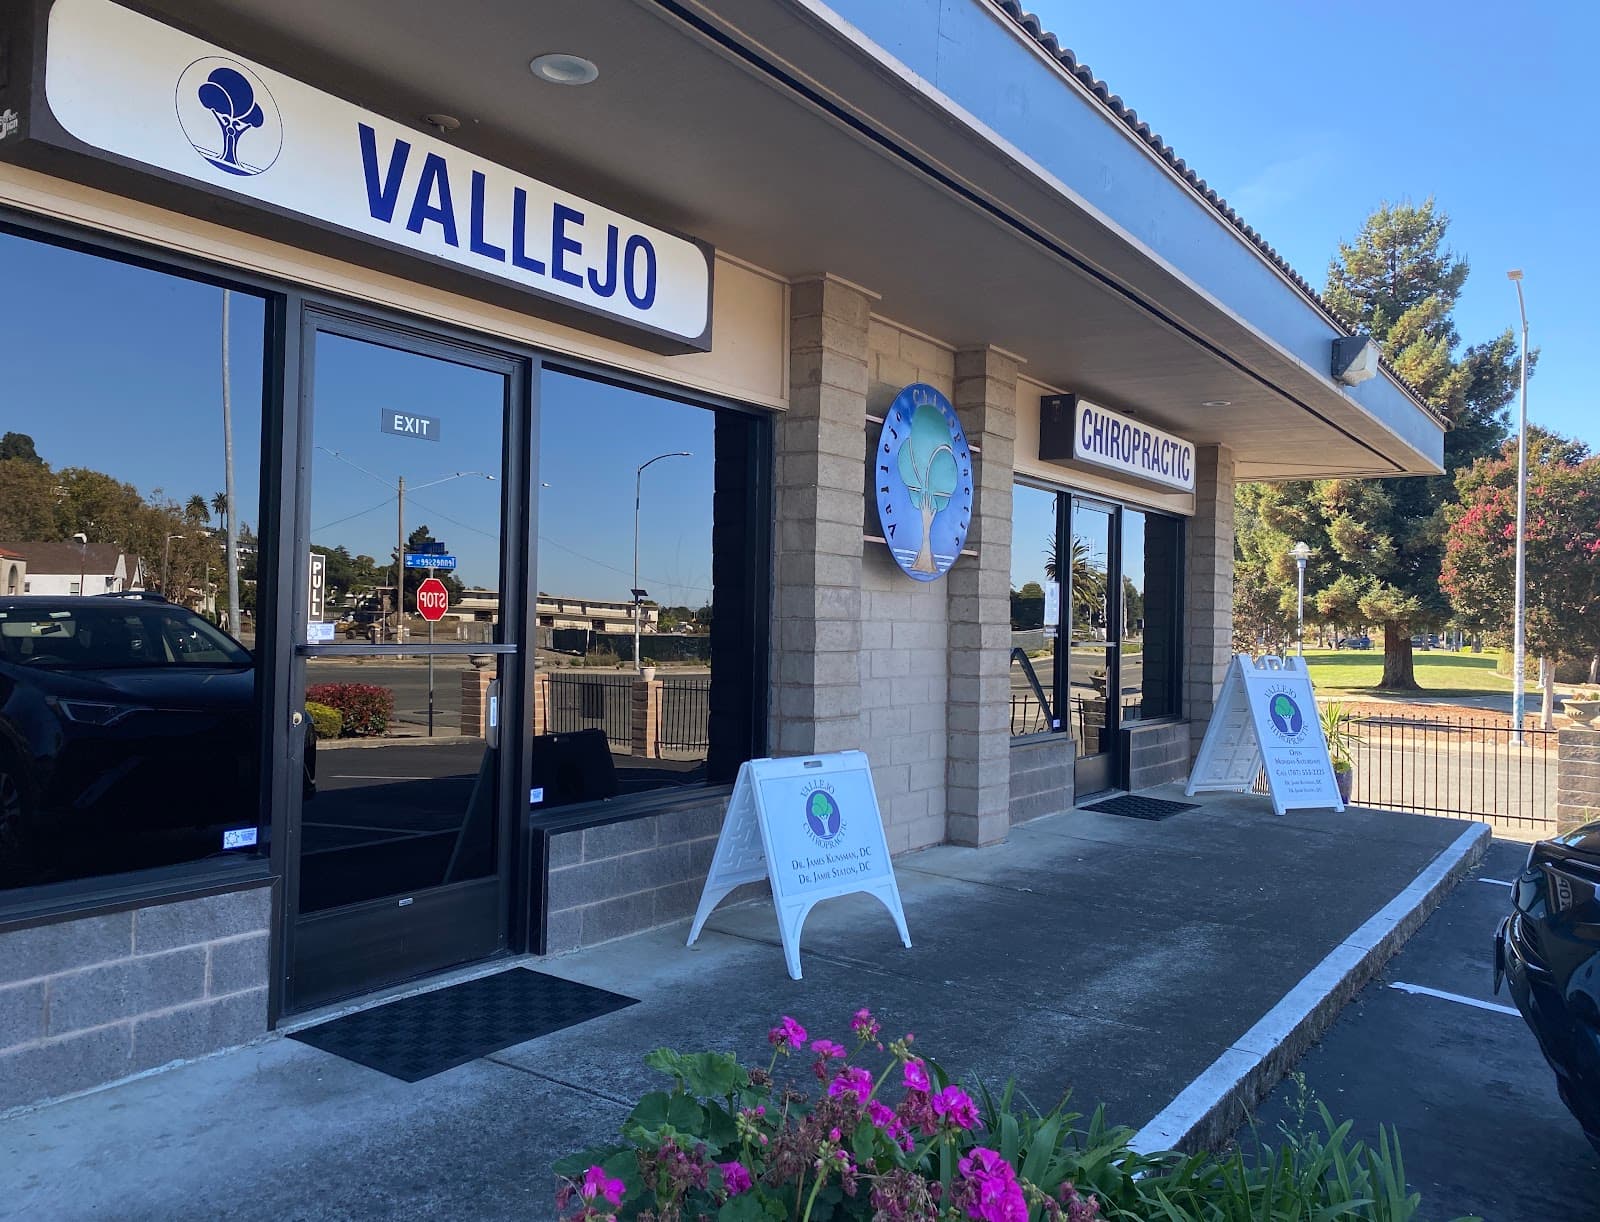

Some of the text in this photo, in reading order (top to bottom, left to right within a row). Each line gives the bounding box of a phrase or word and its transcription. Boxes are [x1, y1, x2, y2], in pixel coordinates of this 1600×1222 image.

[357, 122, 657, 311] VALLEJO
[394, 414, 430, 436] EXIT
[1081, 408, 1191, 482] CHIROPRACTIC
[311, 561, 322, 616] PULL
[1264, 683, 1297, 699] VALLEJO
[800, 779, 835, 798] VALLEJO
[802, 818, 848, 849] CHIROPRACTIC
[859, 846, 872, 857] DC
[859, 861, 871, 872] DC
